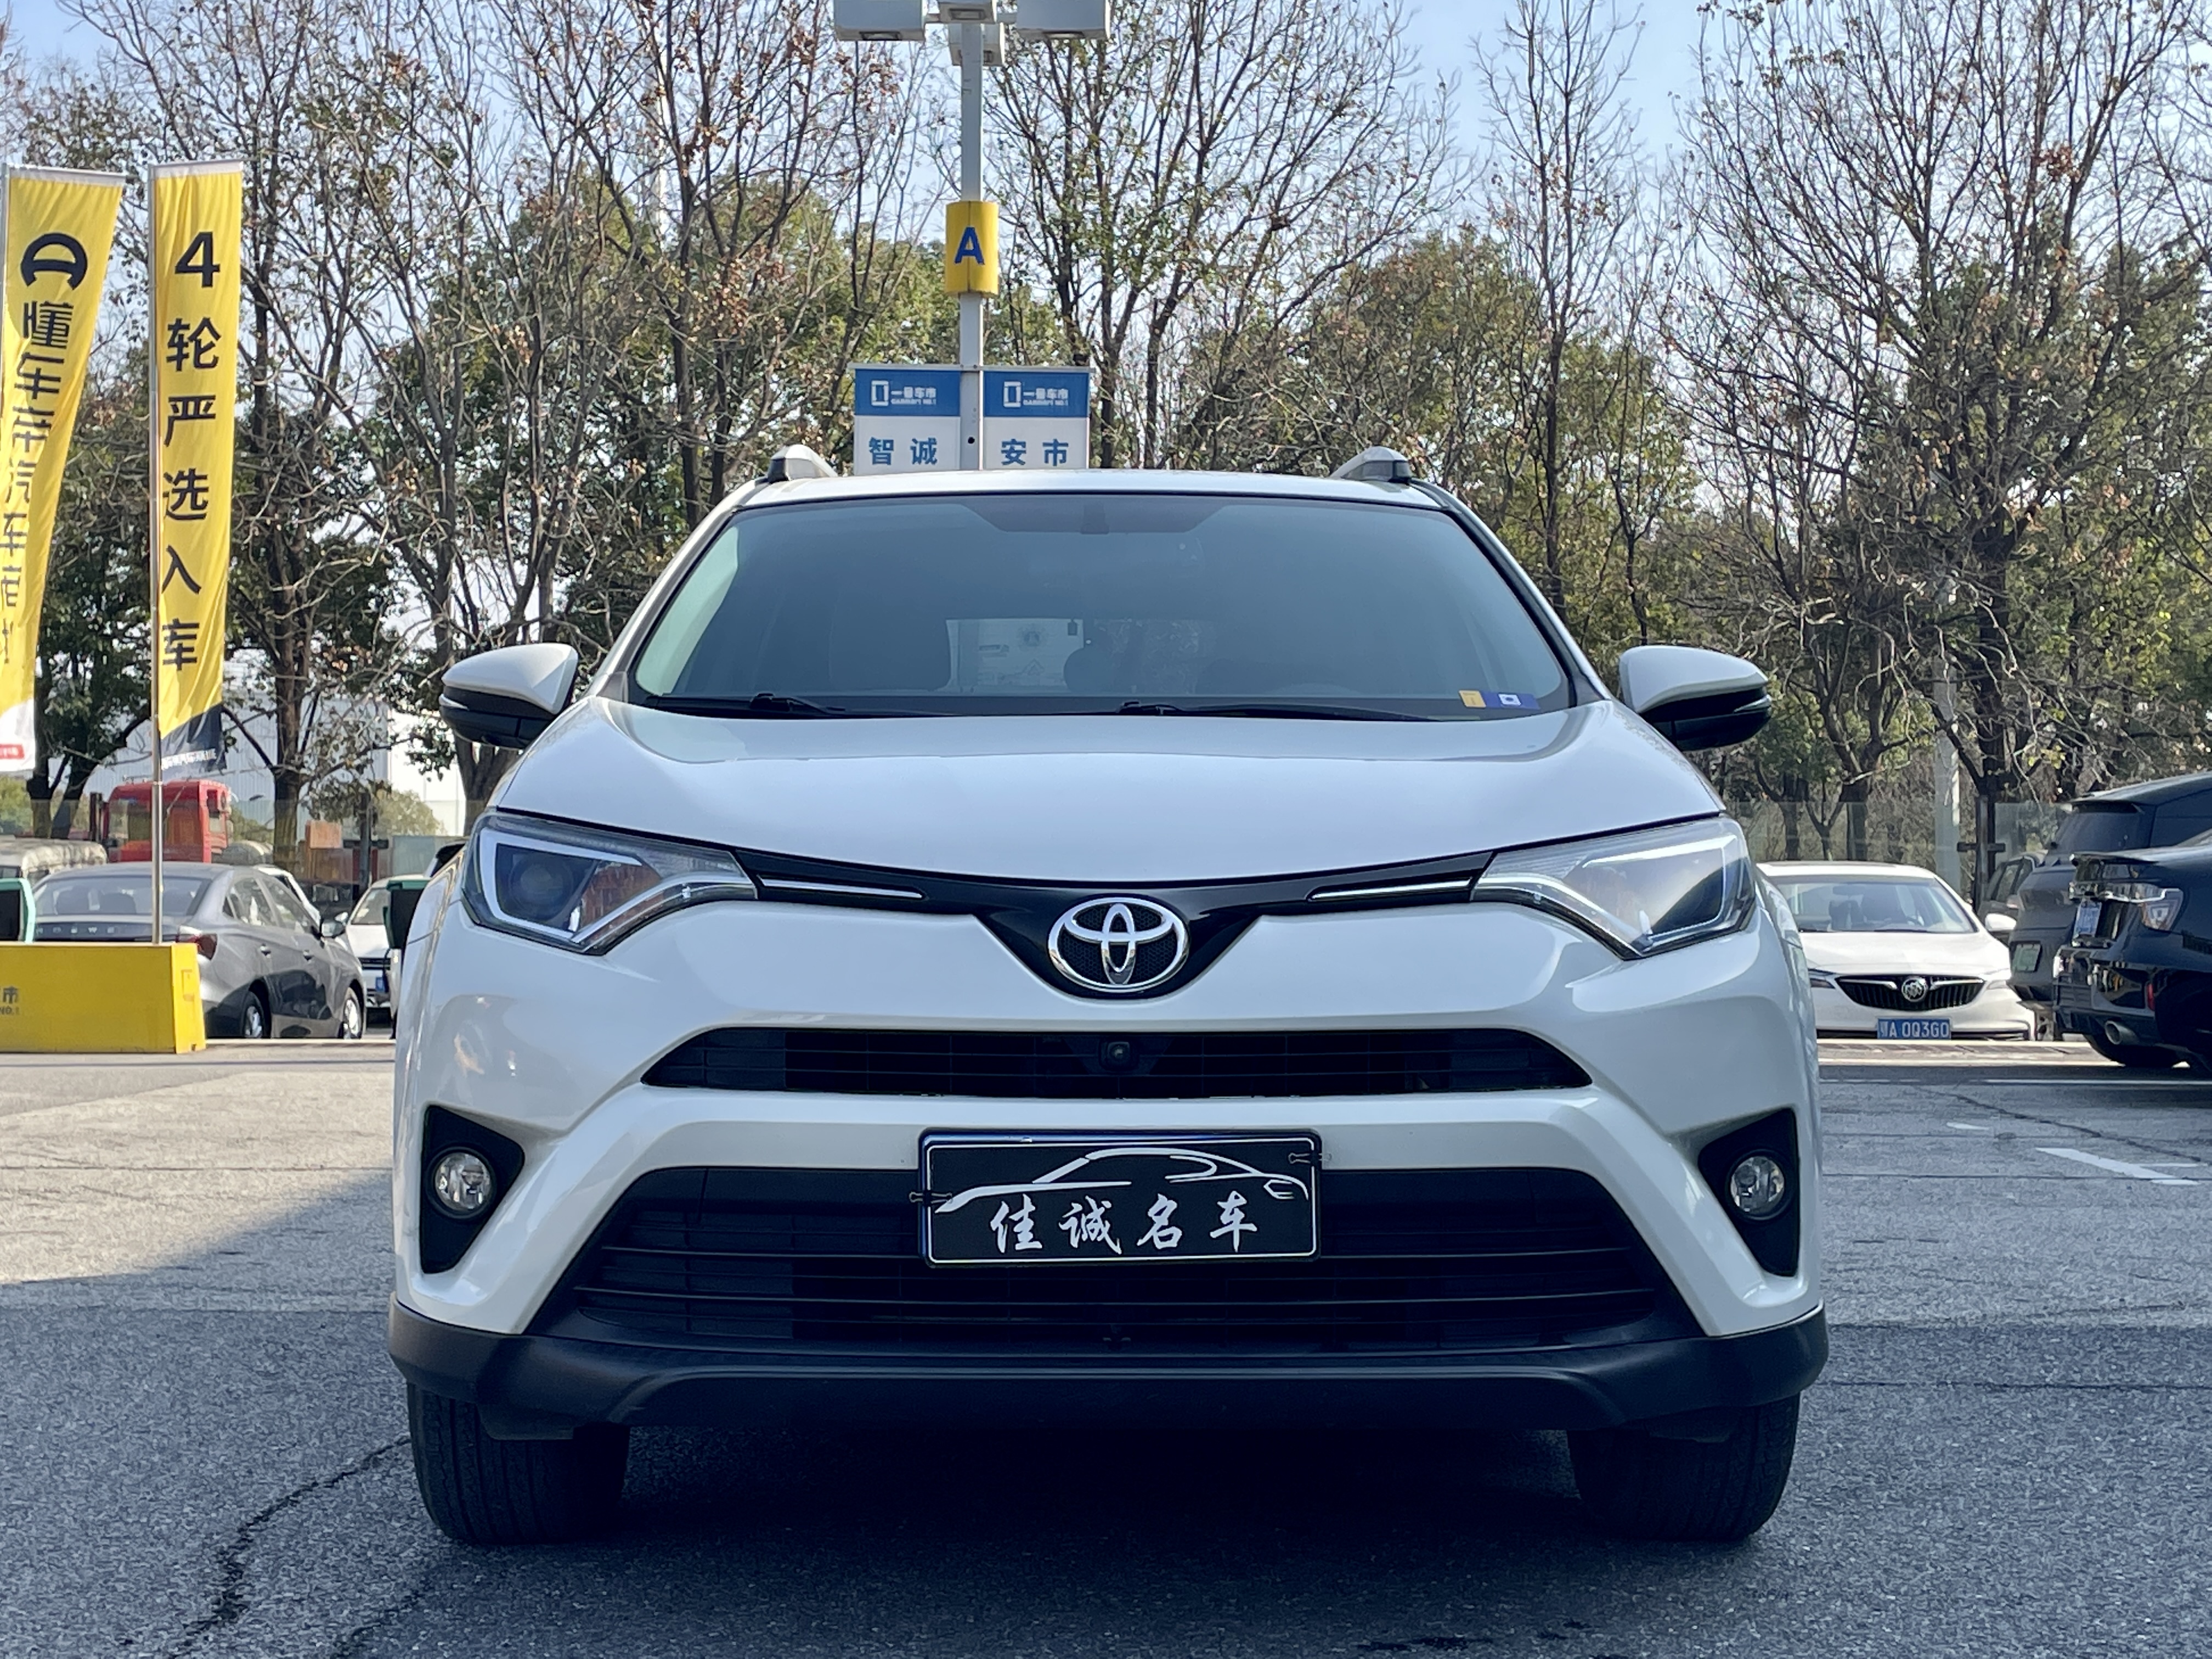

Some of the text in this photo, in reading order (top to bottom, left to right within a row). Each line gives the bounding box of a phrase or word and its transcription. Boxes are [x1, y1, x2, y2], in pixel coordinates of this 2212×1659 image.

[955, 227, 984, 264] A
[868, 437, 938, 465] 智诚
[1001, 438, 1069, 466] 安市
